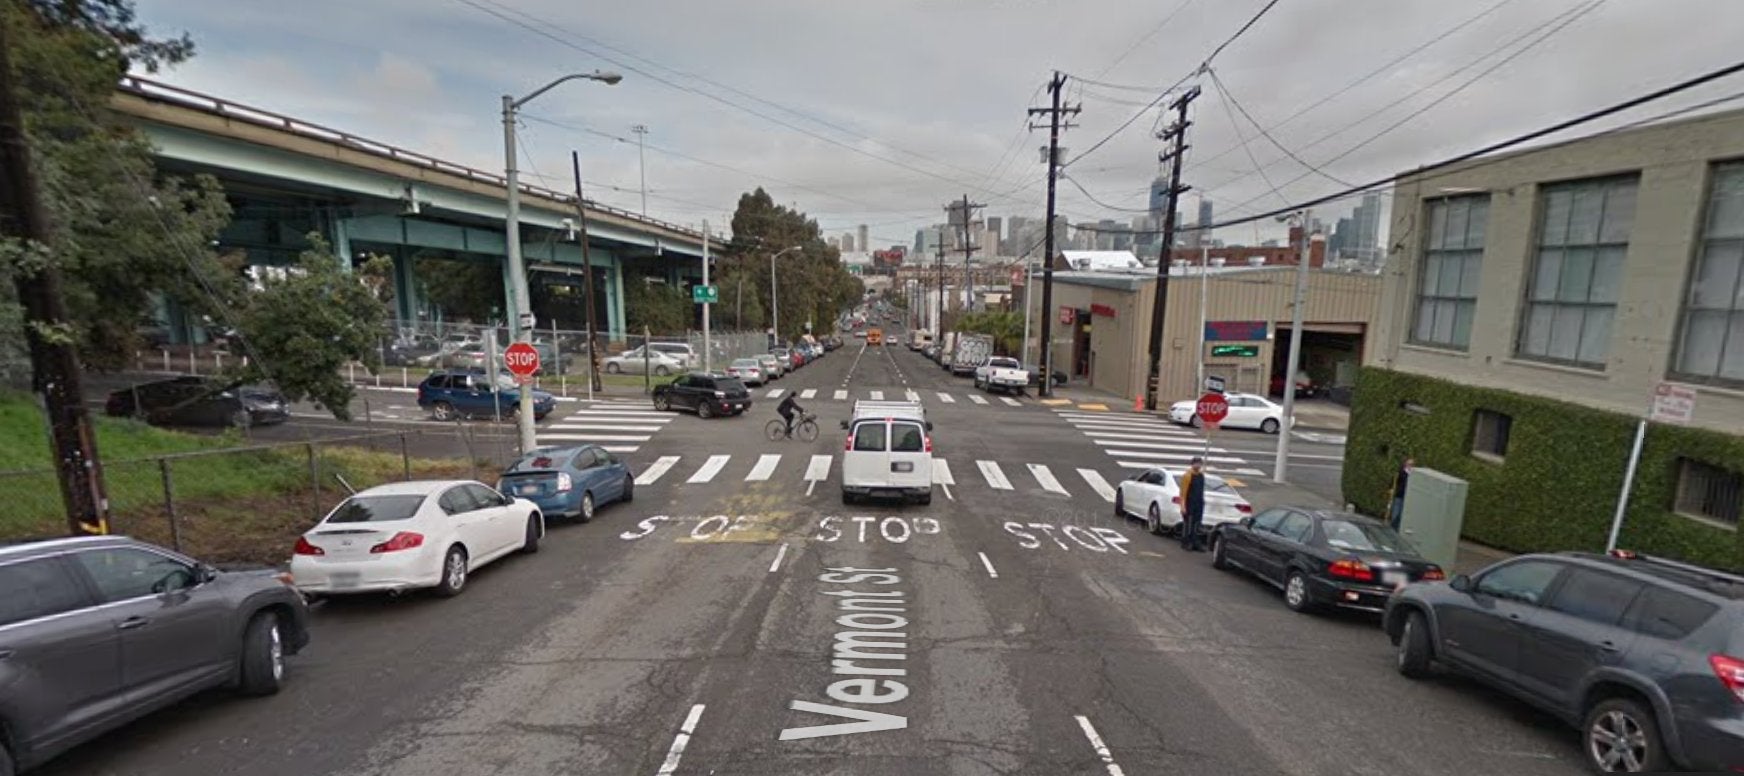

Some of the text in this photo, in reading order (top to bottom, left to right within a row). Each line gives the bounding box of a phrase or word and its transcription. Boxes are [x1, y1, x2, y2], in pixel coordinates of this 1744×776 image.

[505, 351, 536, 367] STOP
[1198, 401, 1227, 416] STOP
[815, 515, 941, 544] STOP
[1003, 520, 1131, 555] STOP
